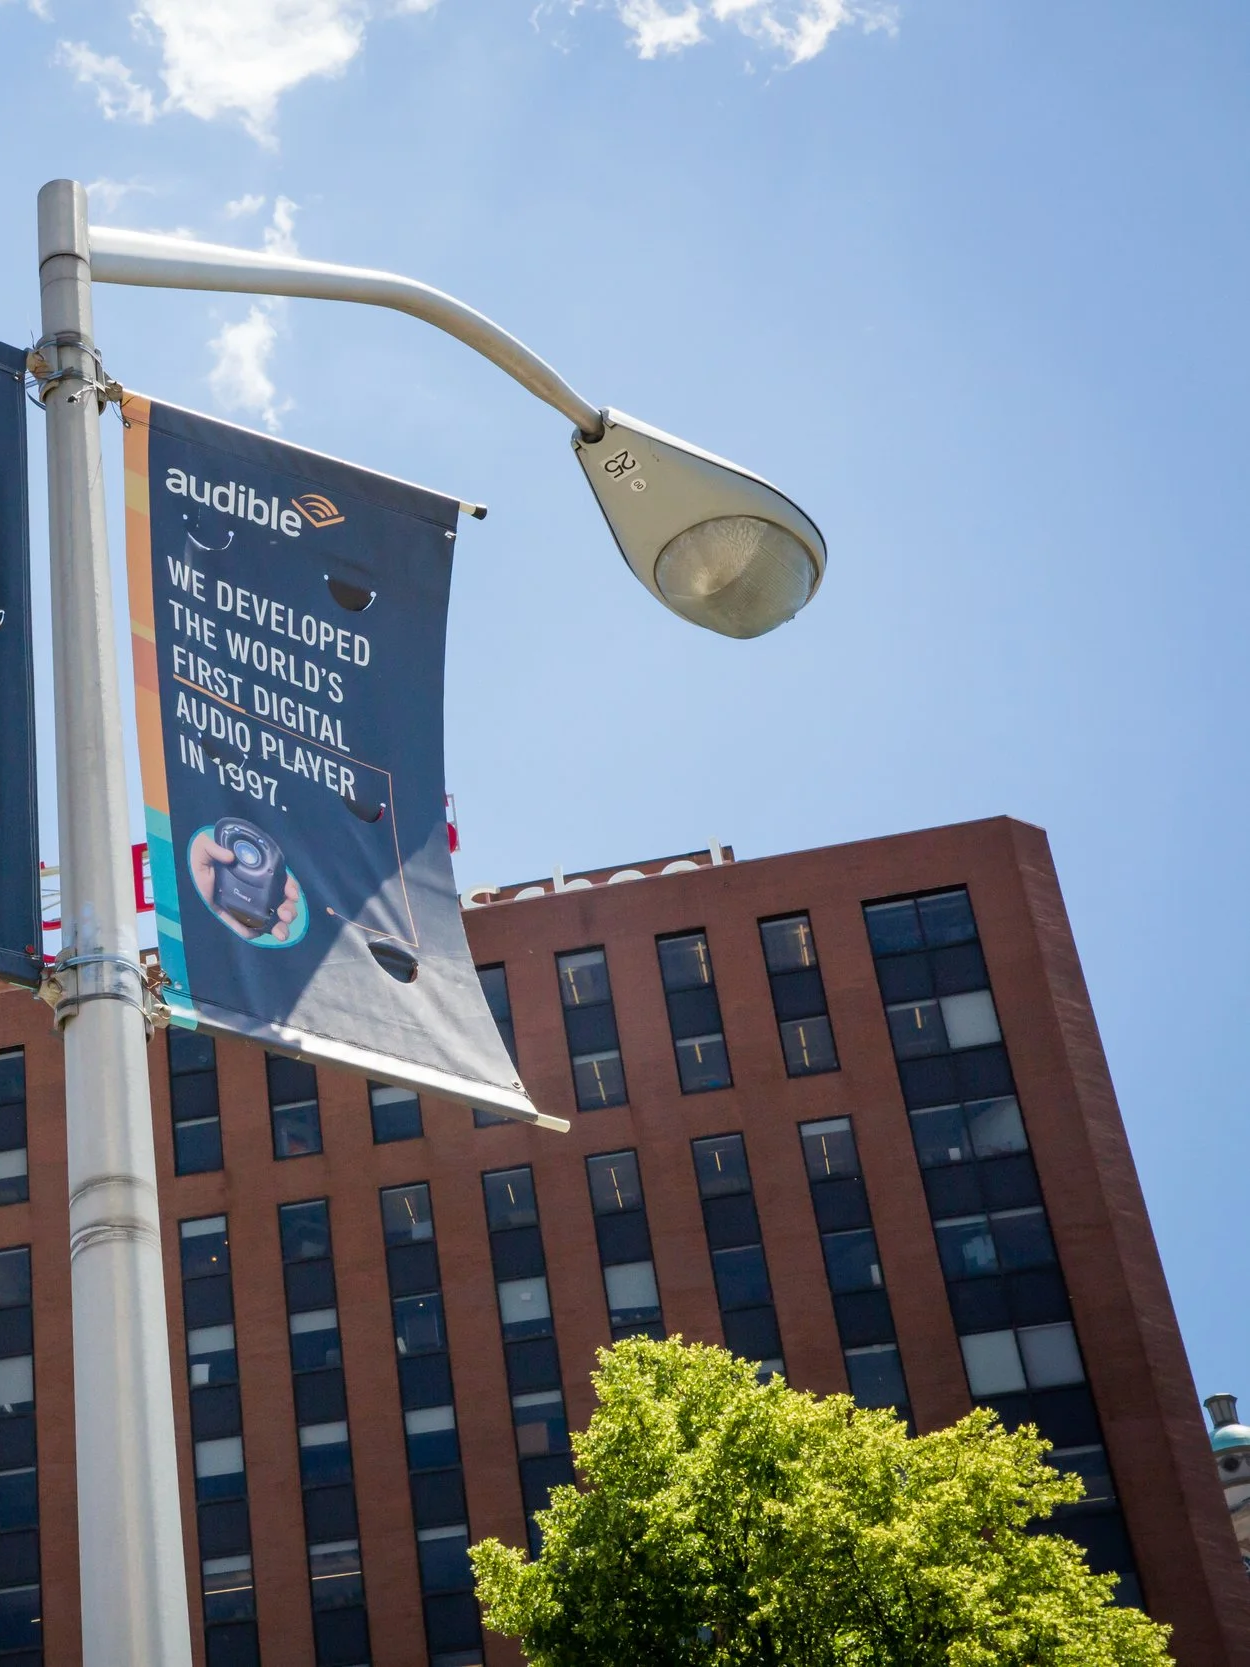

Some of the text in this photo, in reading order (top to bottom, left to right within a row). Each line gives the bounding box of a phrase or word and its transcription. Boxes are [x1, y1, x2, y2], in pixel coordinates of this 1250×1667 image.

[165, 468, 301, 537] audible
[604, 451, 636, 479] 25
[167, 555, 370, 667] WE DEVELOPED
[168, 599, 344, 704] THE WORLD'S
[173, 644, 351, 752] FIRST DIGITAL
[176, 691, 356, 801] AUDIO PLAYER
[179, 734, 288, 812] IN 1997.
